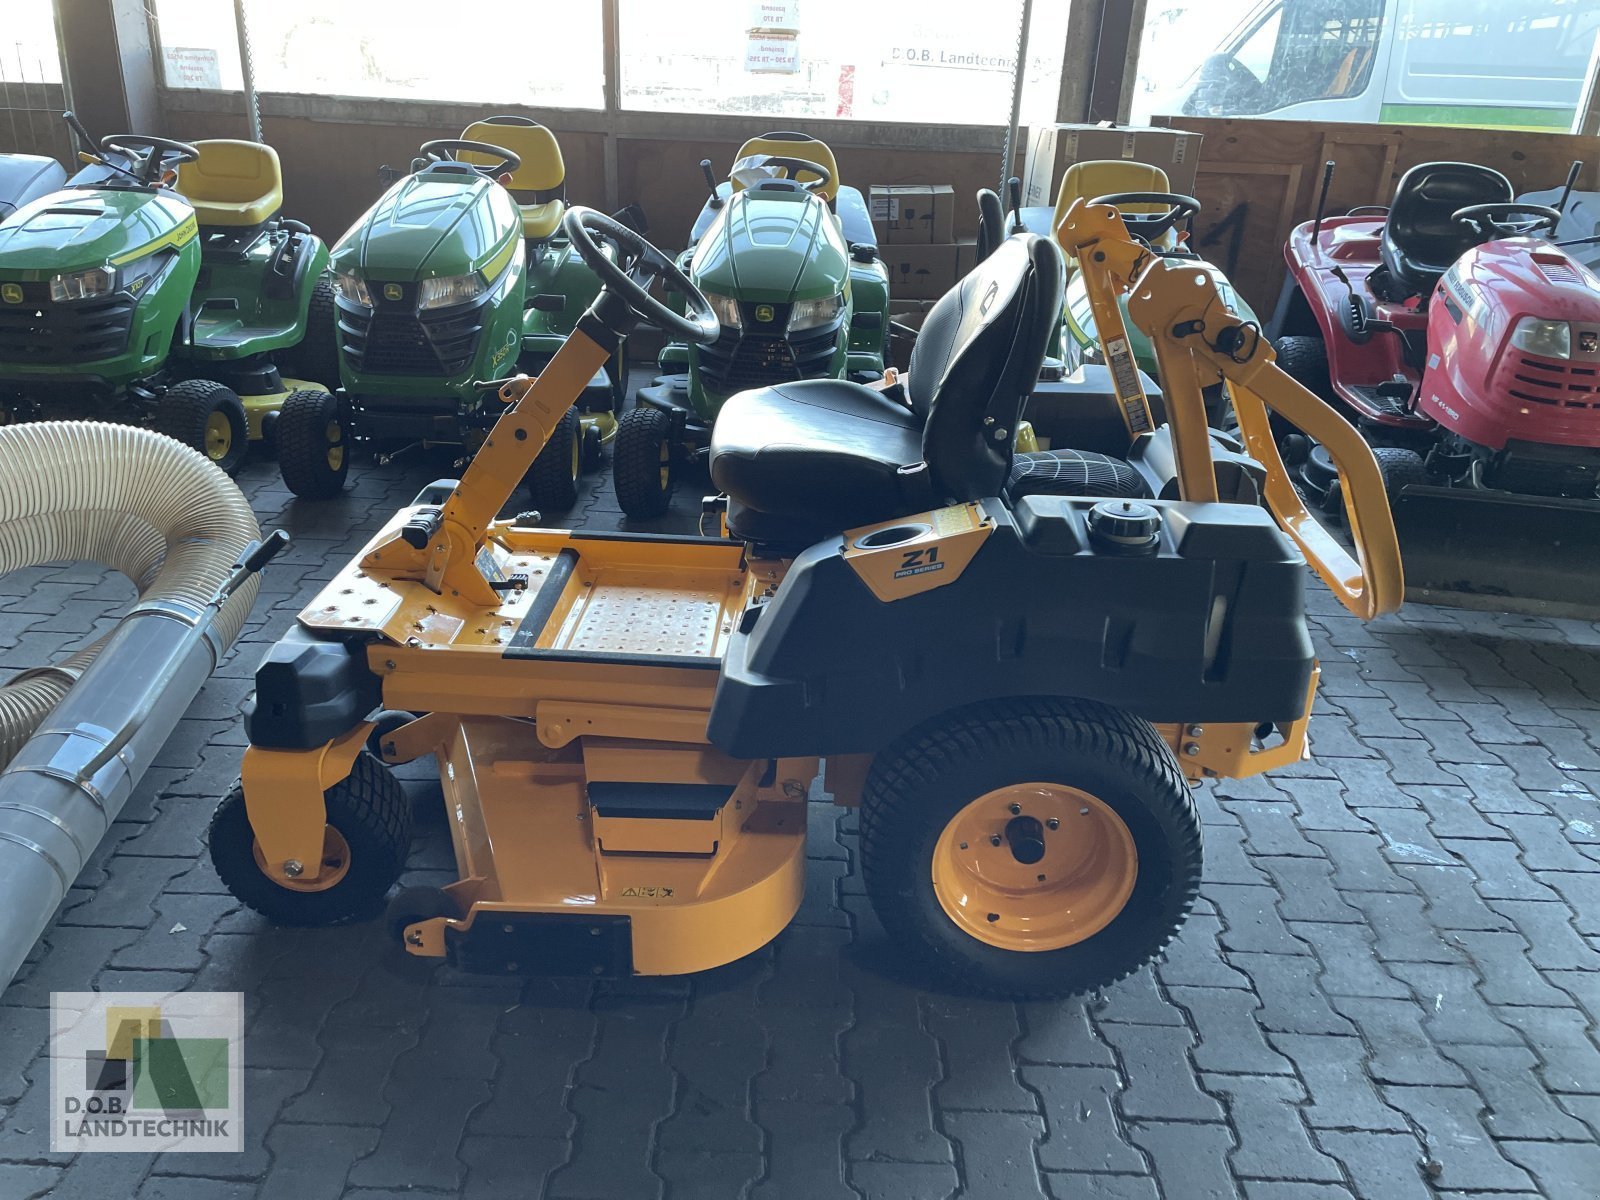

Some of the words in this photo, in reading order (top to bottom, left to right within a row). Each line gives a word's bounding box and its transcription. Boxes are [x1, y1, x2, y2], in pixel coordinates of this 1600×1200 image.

[901, 546, 939, 569] Z1
[895, 569, 913, 578] PRO
[914, 563, 943, 574] SERIES
